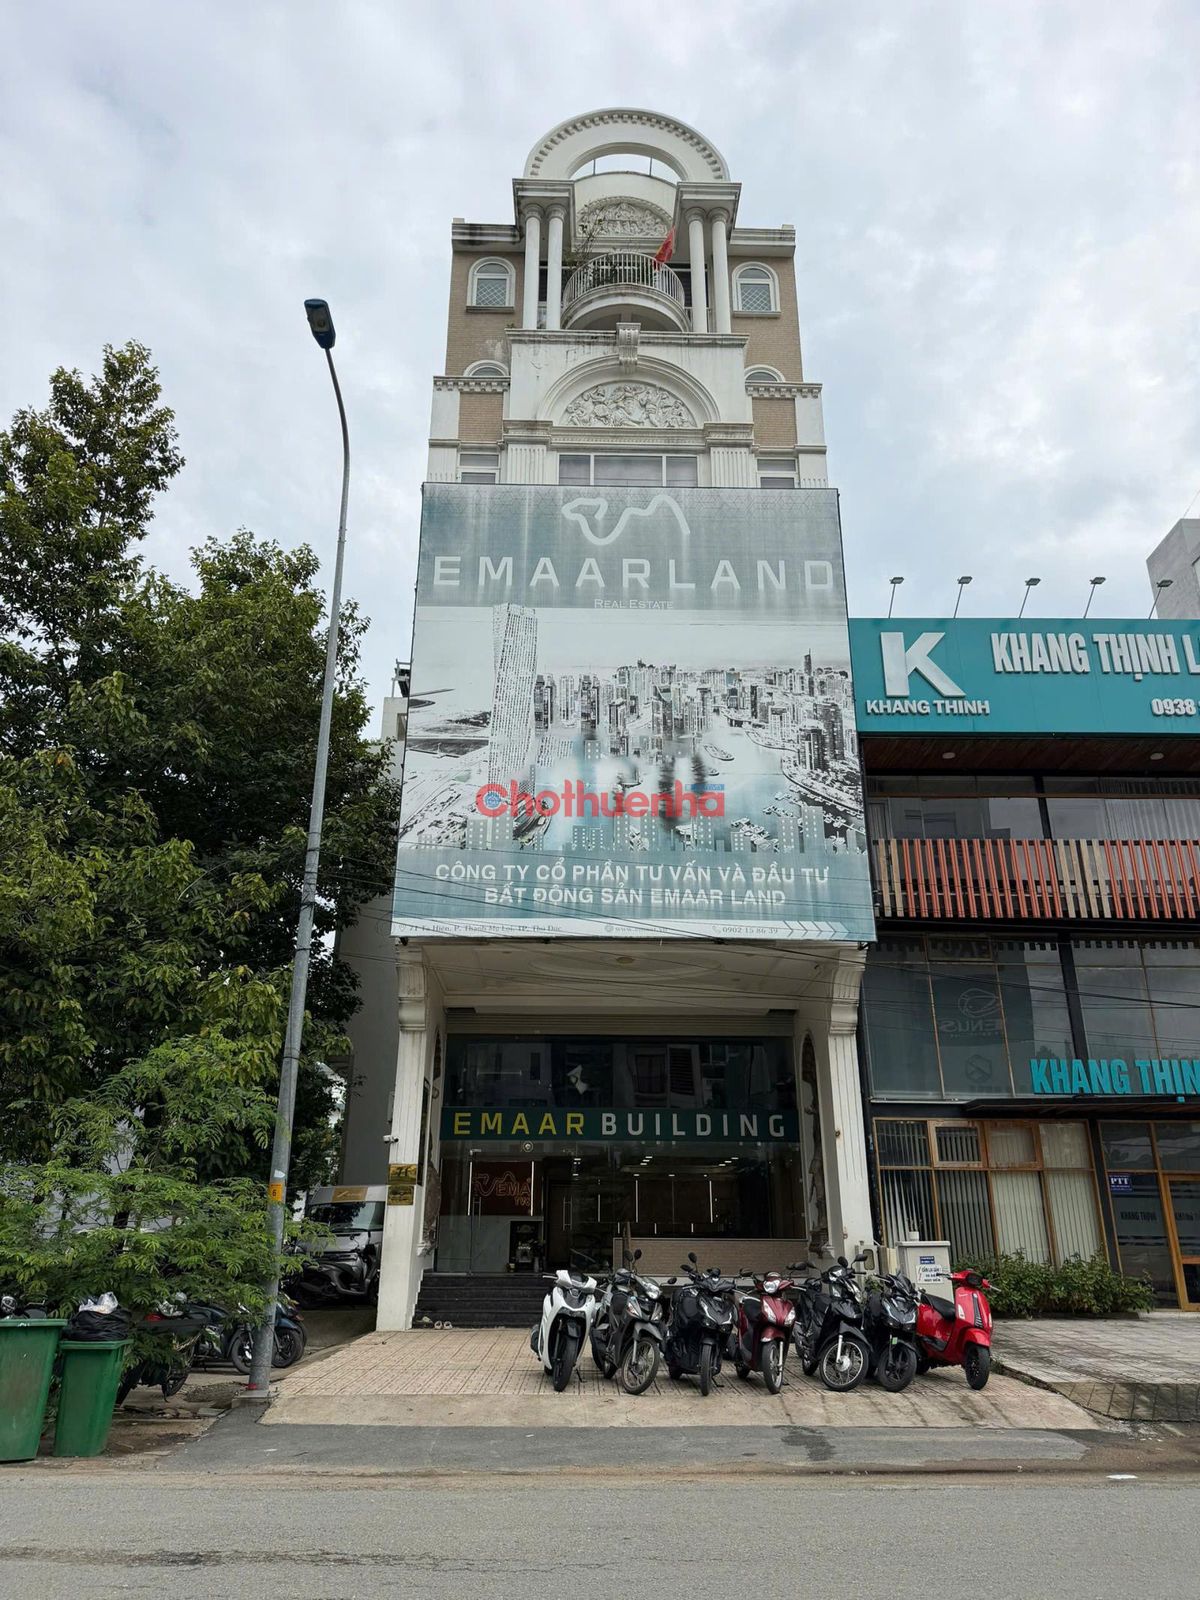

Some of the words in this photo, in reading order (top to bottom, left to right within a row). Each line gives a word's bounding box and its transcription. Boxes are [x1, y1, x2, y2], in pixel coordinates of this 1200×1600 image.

[880, 632, 967, 698] K
[991, 632, 1091, 674] KHANG
[1093, 633, 1181, 681] THỊNH
[866, 699, 930, 715] KHANG
[933, 700, 991, 715] THINH
[1151, 698, 1197, 716] 0938
[435, 861, 496, 880] CÔNG
[503, 865, 530, 881] TY
[536, 857, 566, 881] CỔ
[572, 859, 629, 881] PHẦN
[635, 864, 664, 881] TƯ
[669, 860, 711, 882] VẤN
[718, 863, 746, 882] VÀ
[752, 861, 794, 882] ĐẦU
[801, 866, 830, 884] TƯ
[485, 881, 527, 903] BẤT
[533, 884, 594, 905] ĐỘNG
[600, 882, 643, 904] SẢN
[651, 888, 723, 905] EMAAR
[731, 889, 786, 906] LAND
[1030, 1058, 1132, 1094] KHANG
[453, 1112, 585, 1136] EMAAR
[601, 1113, 785, 1137] BUILDING
